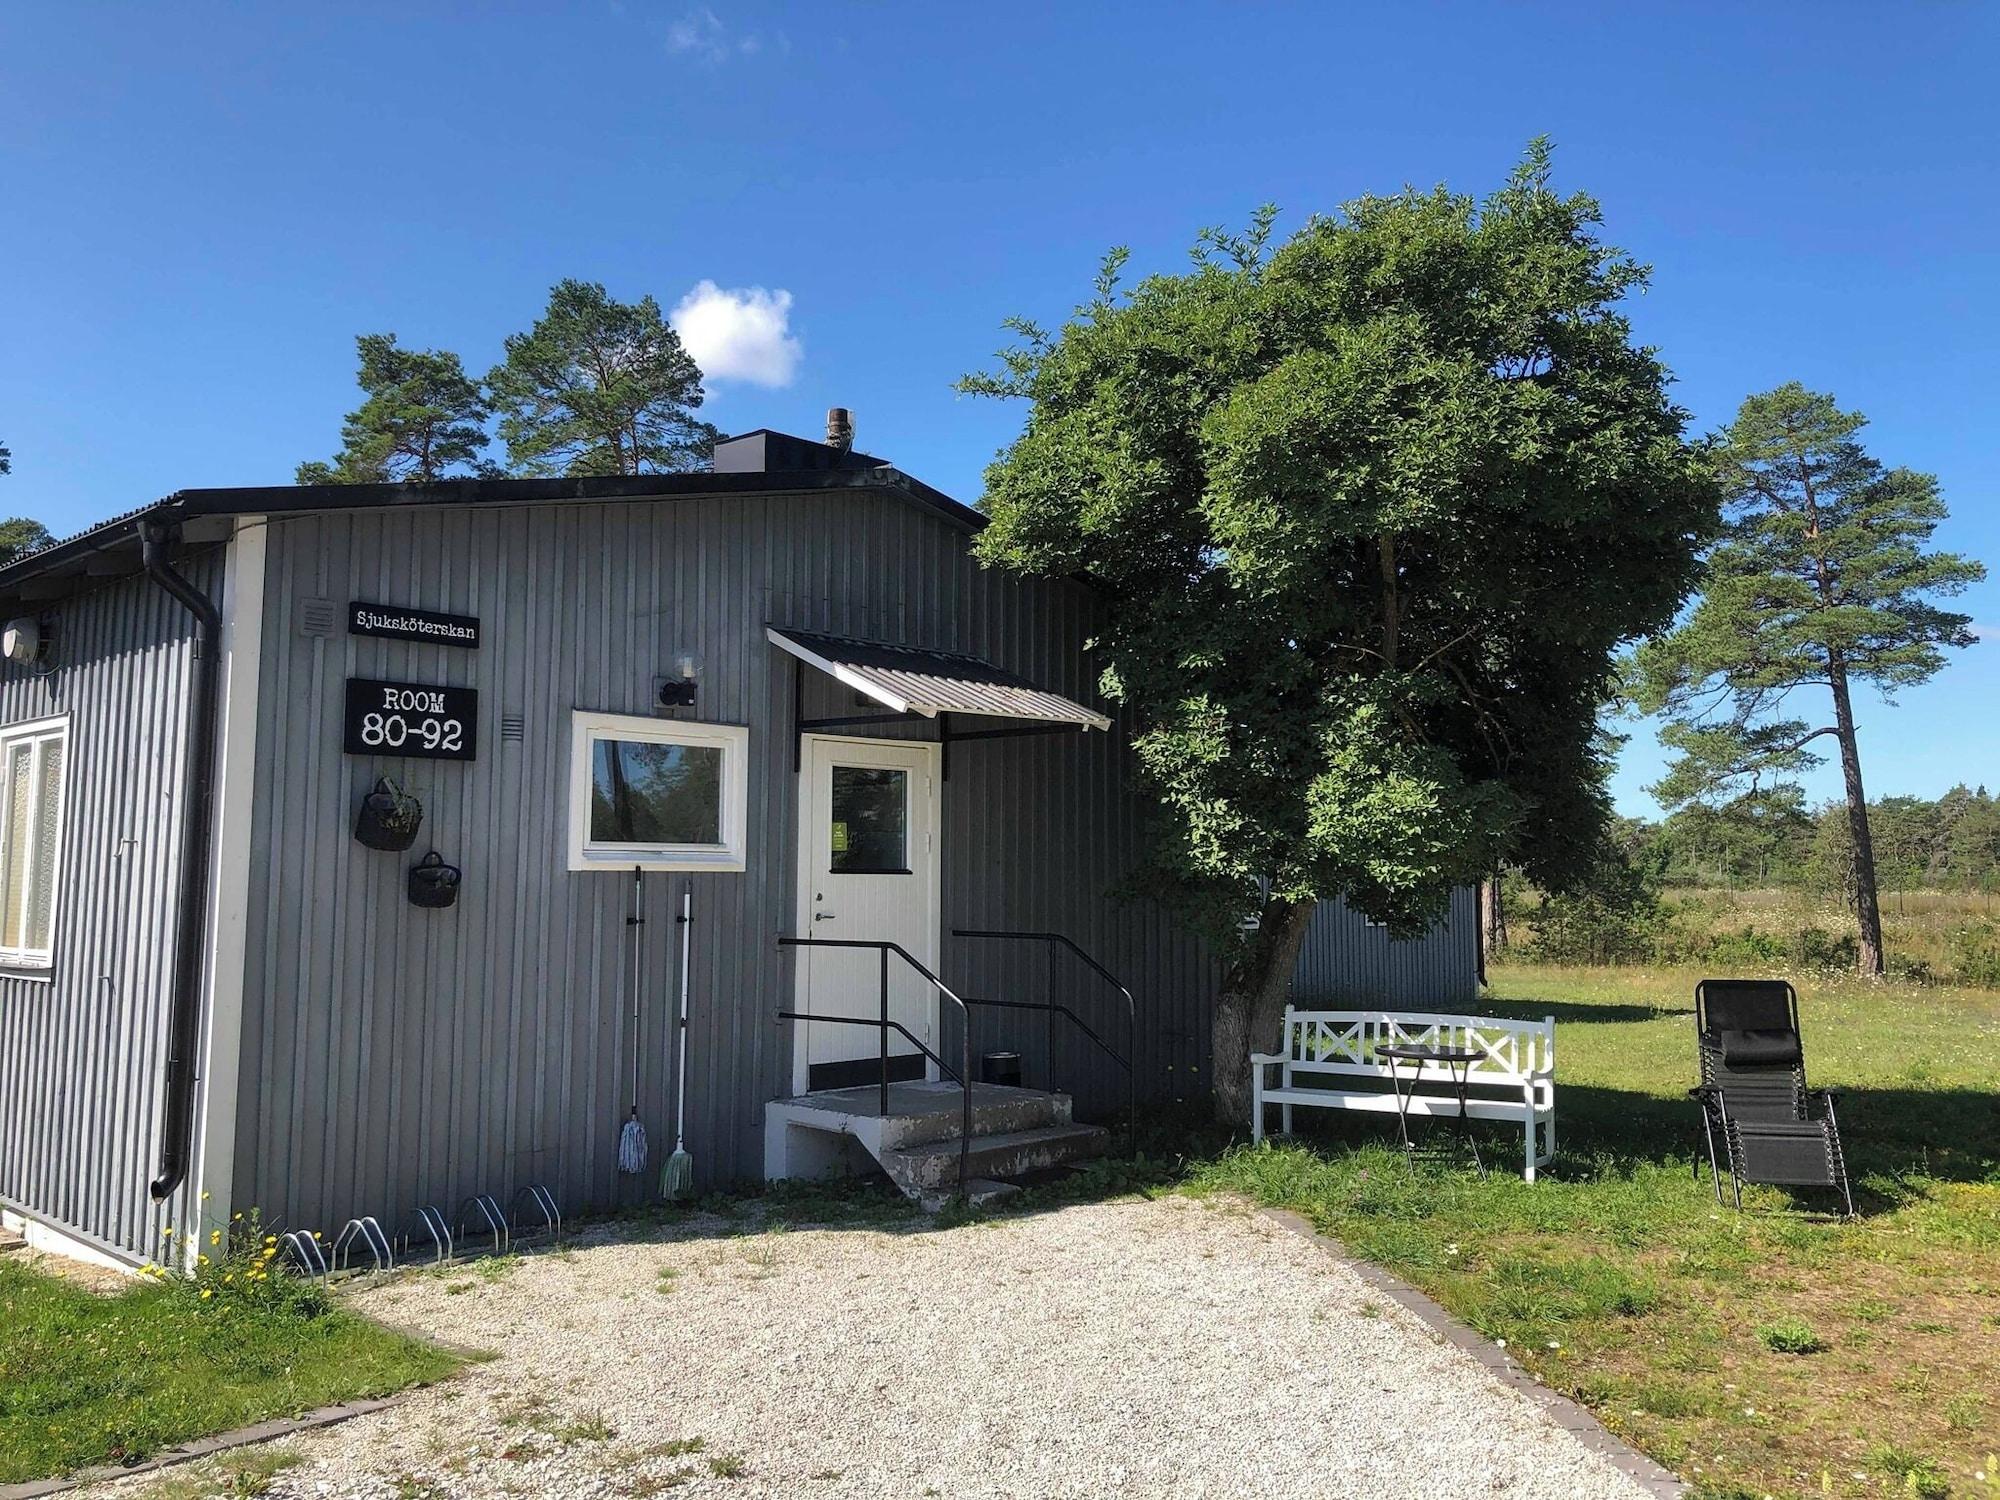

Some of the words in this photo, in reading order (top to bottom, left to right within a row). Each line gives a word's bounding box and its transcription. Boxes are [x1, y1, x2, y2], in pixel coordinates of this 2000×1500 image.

[357, 611, 475, 639] Sjuksköterskan
[382, 688, 445, 713] ROOM
[361, 713, 463, 751] 80-92
